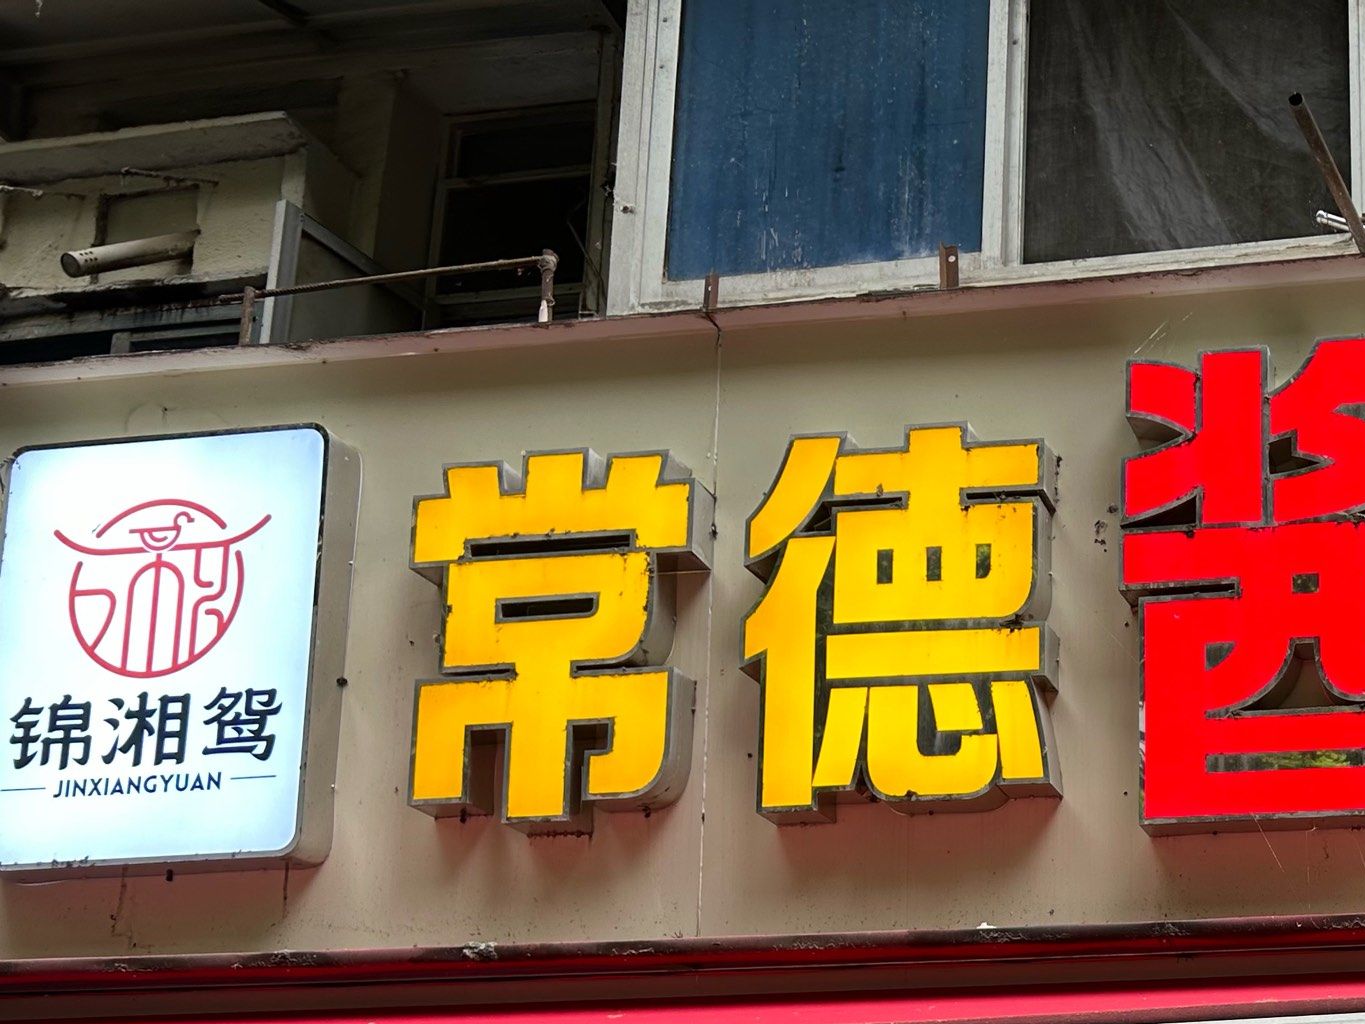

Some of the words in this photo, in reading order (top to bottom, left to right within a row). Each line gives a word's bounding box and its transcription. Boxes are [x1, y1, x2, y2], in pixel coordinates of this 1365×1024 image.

[9, 687, 283, 771] 锦湘鸳
[53, 772, 222, 798] JINXIANGYUAN
